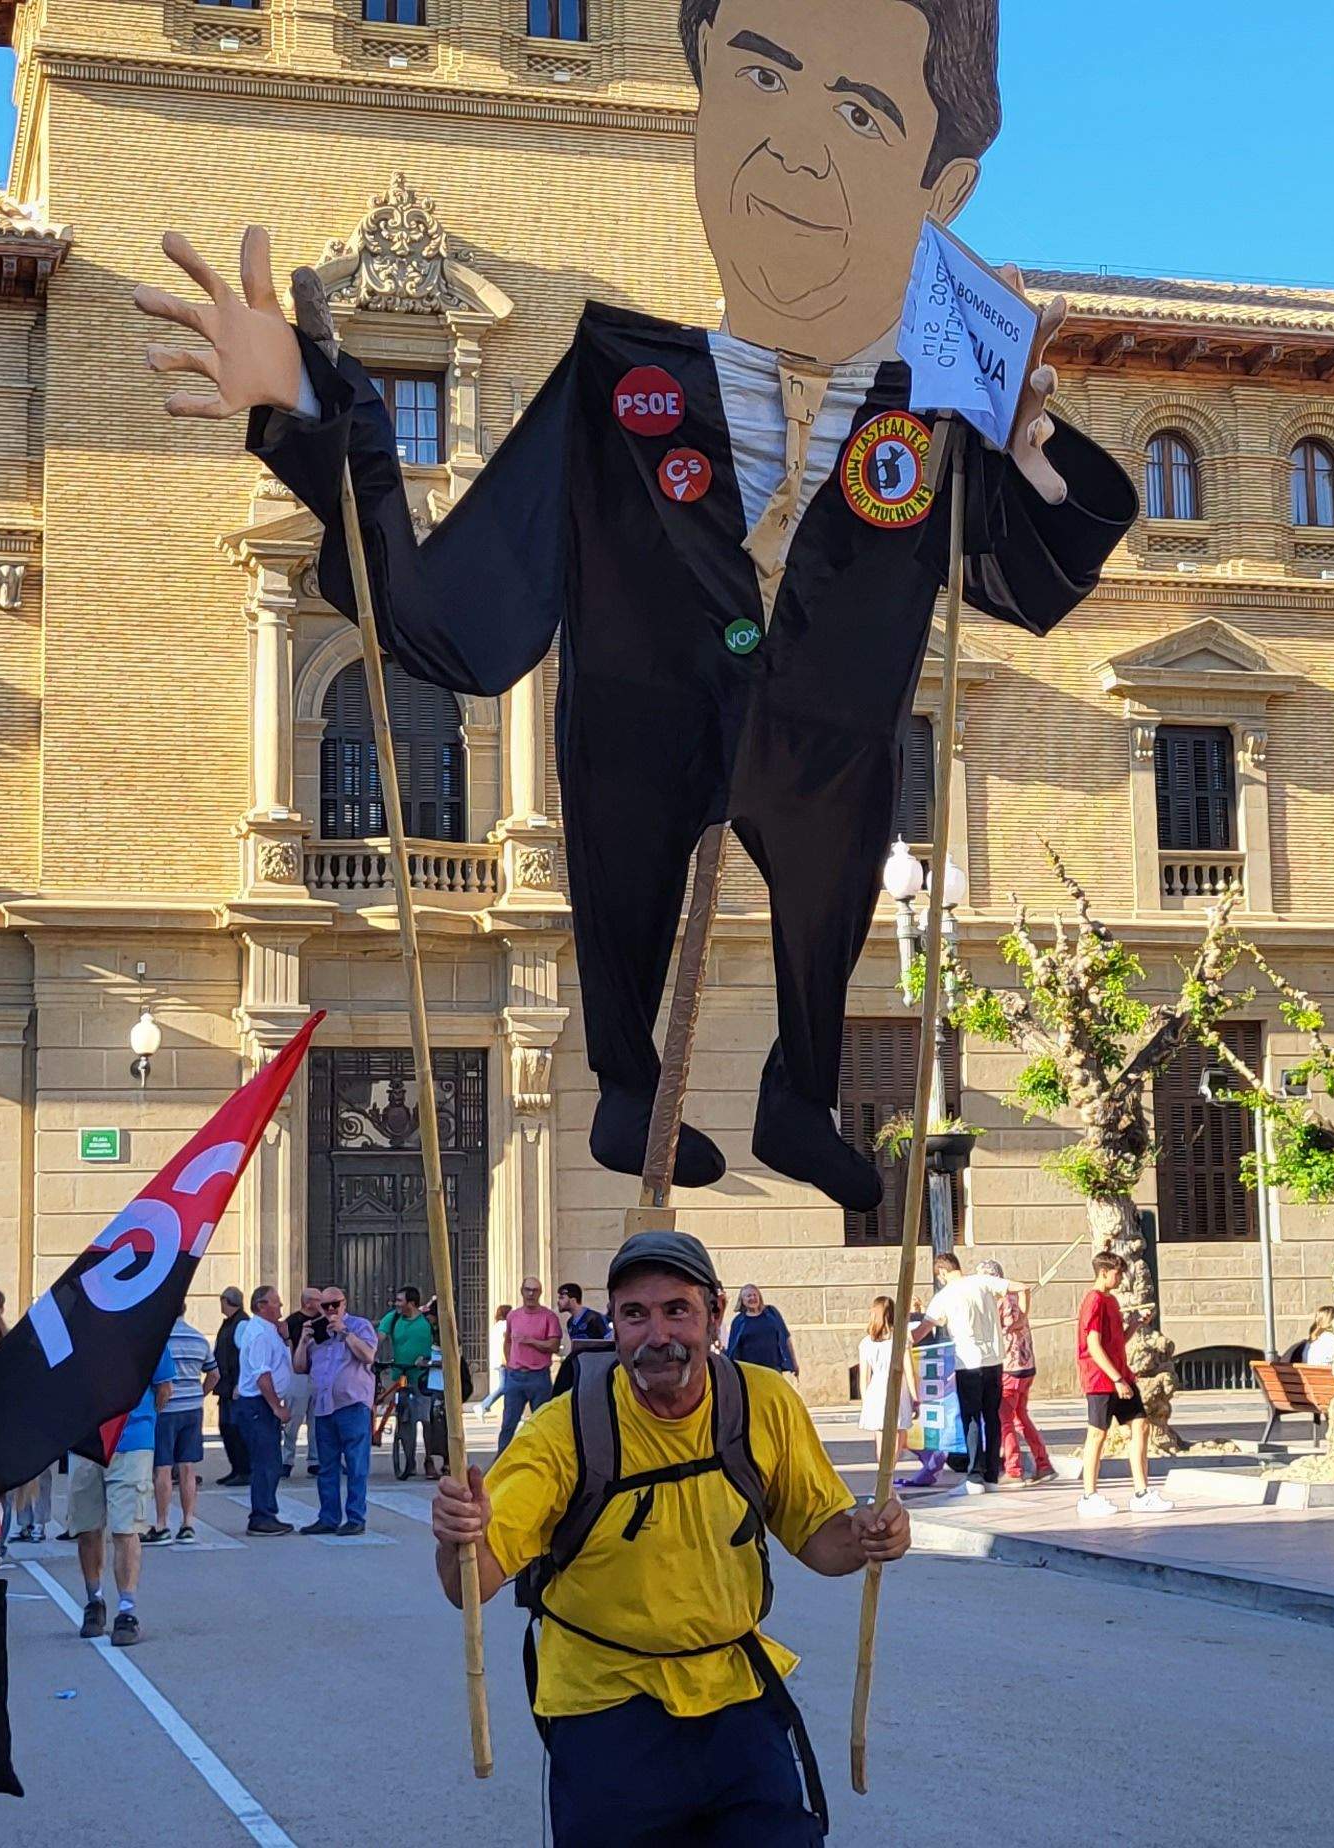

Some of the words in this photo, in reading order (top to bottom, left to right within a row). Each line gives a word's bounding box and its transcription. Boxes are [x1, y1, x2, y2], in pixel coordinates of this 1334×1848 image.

[957, 281, 1020, 343] BOMBEROS
[617, 392, 680, 417] PSOE
[856, 431, 876, 454] LAS
[666, 459, 702, 482] Cs
[847, 457, 871, 509] MUCHO
[868, 502, 918, 522] MUCHO
[727, 625, 760, 649] VOX
